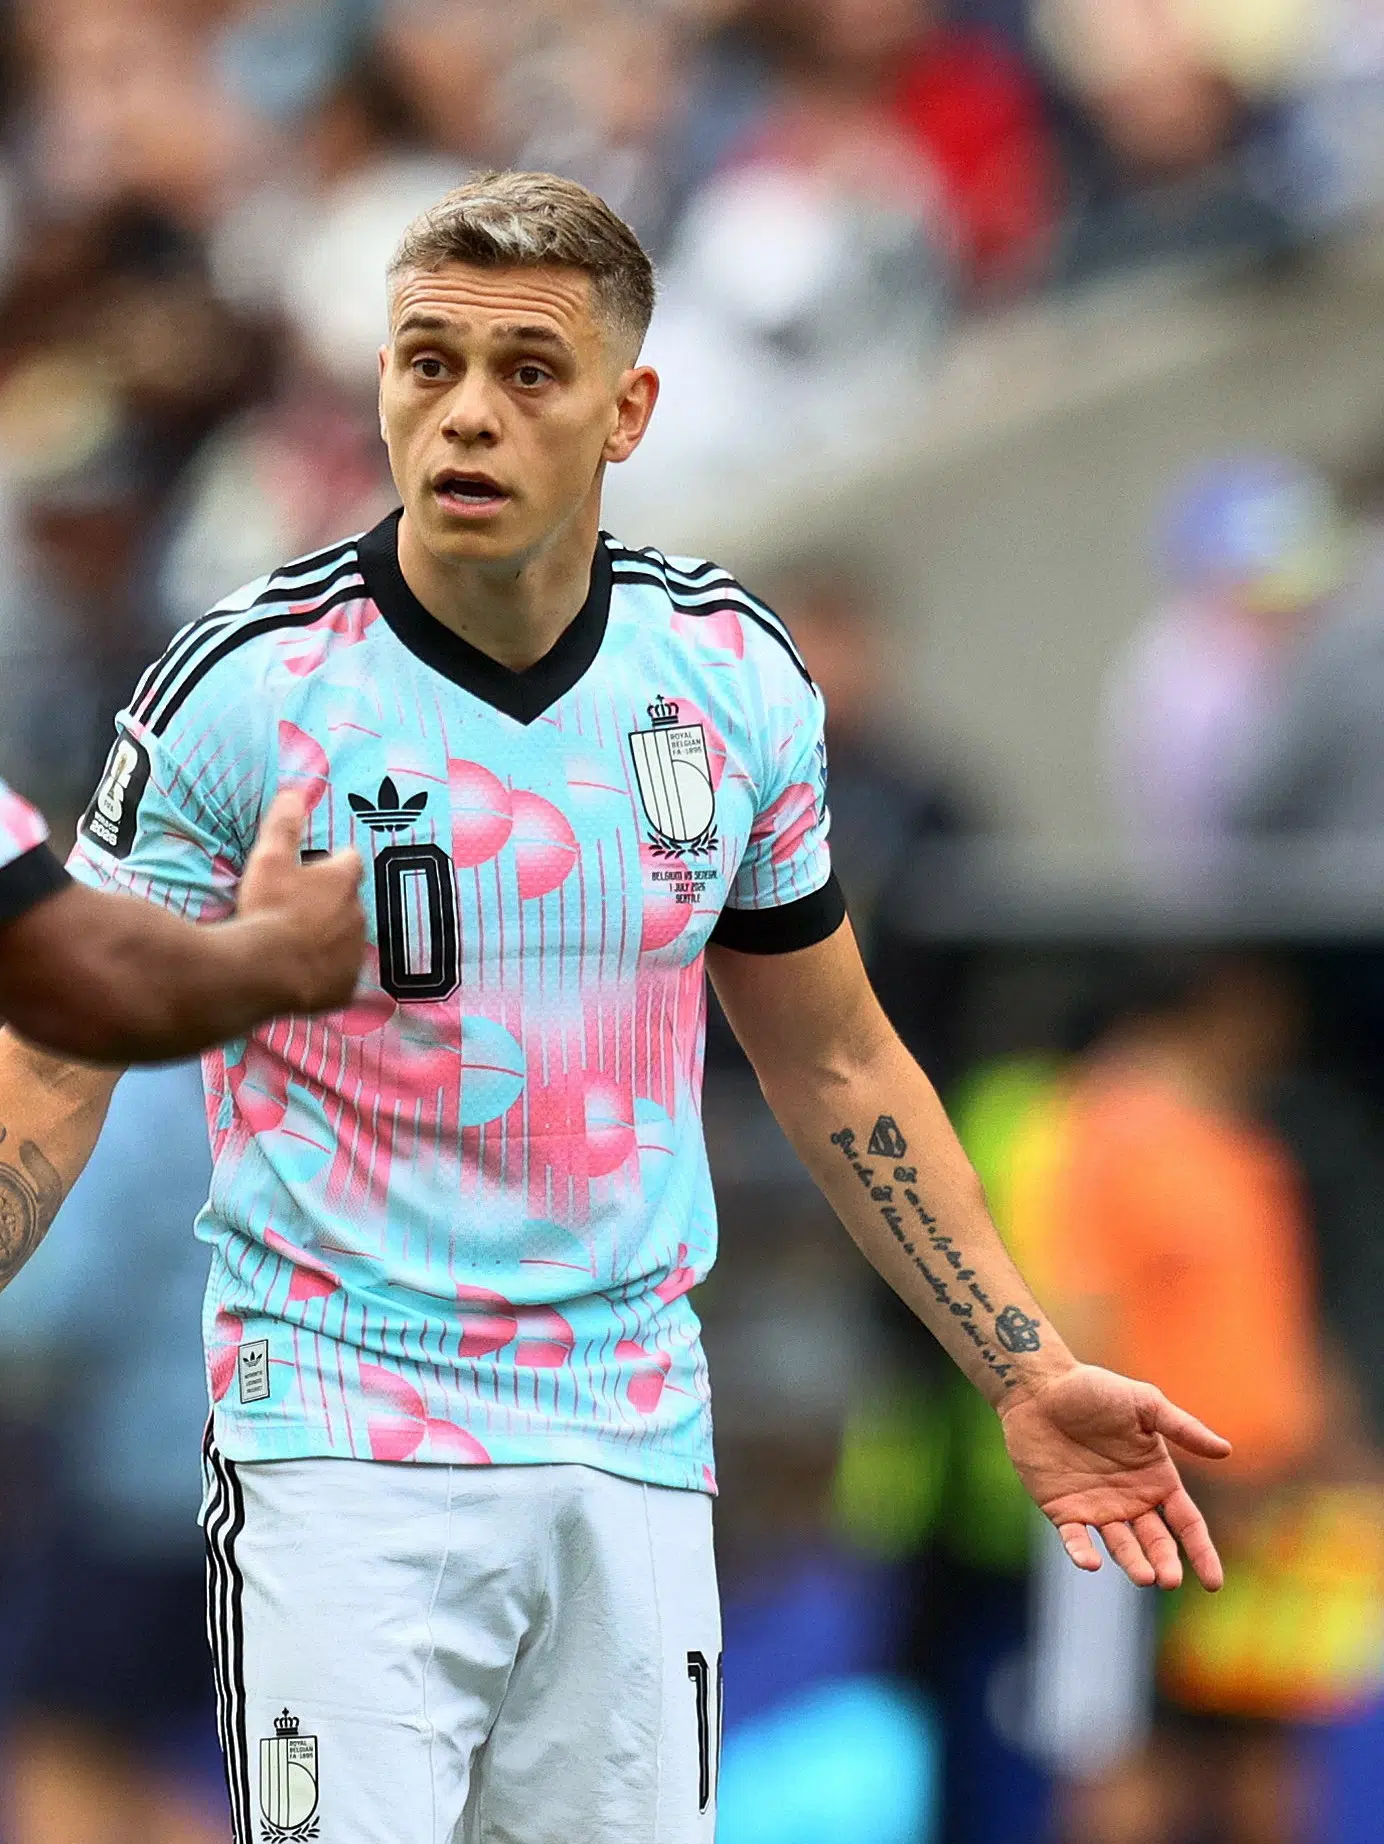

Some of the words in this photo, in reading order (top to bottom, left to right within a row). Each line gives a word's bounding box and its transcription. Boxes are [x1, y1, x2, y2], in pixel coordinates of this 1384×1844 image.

[670, 732, 693, 740] ROYAL
[671, 739, 702, 748] BELGIAN
[652, 871, 682, 881] BELGIUM
[684, 871, 693, 880] VS
[674, 882, 689, 892] JULY
[676, 894, 700, 904] SEATTLE
[687, 1650, 724, 1815] 1
